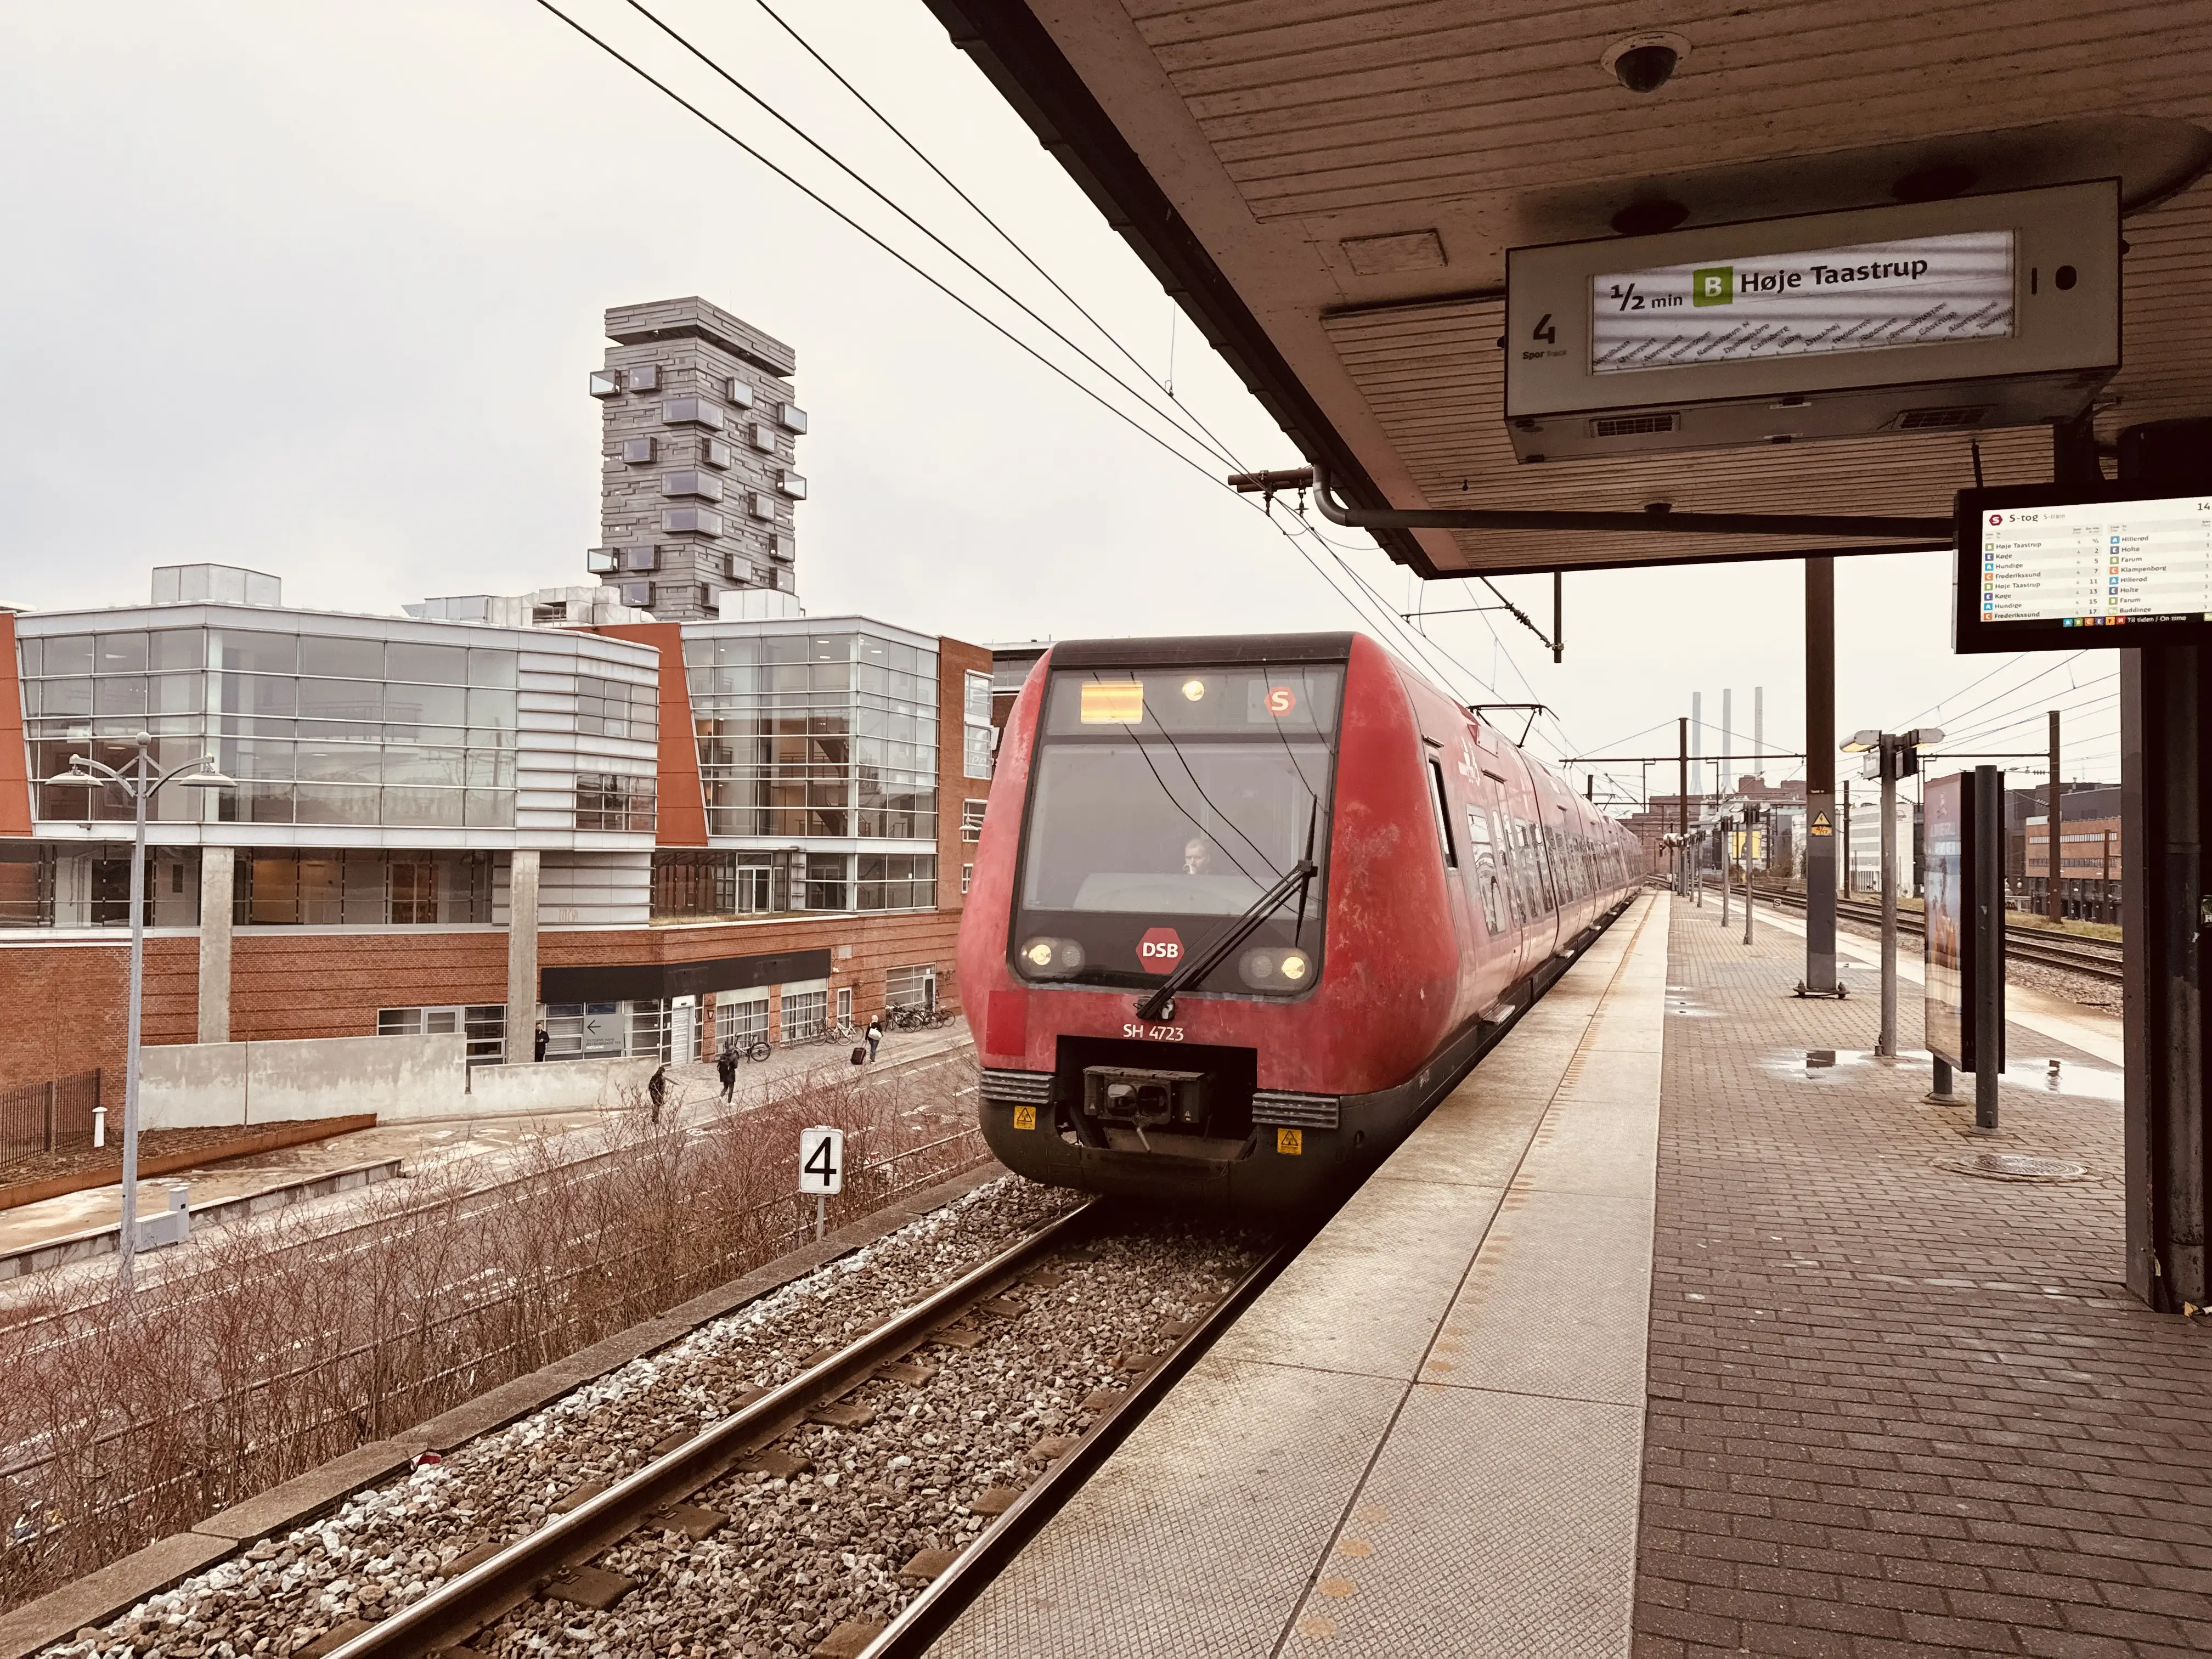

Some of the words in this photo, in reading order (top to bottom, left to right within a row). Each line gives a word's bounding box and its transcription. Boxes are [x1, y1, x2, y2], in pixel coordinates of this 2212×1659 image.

[1741, 269, 1802, 294] Høje
[1811, 259, 1928, 285] Taastrup
[1705, 276, 1722, 297] B
[1651, 294, 1683, 308] min
[1533, 313, 1556, 344] 4
[1523, 351, 1545, 360] Spor
[2197, 503, 2210, 511] 14
[1272, 691, 1289, 711] S
[1143, 942, 1178, 958] DSB
[1123, 1024, 1143, 1038] SH
[1149, 1025, 1184, 1041] 4723
[804, 1137, 837, 1186] 4
